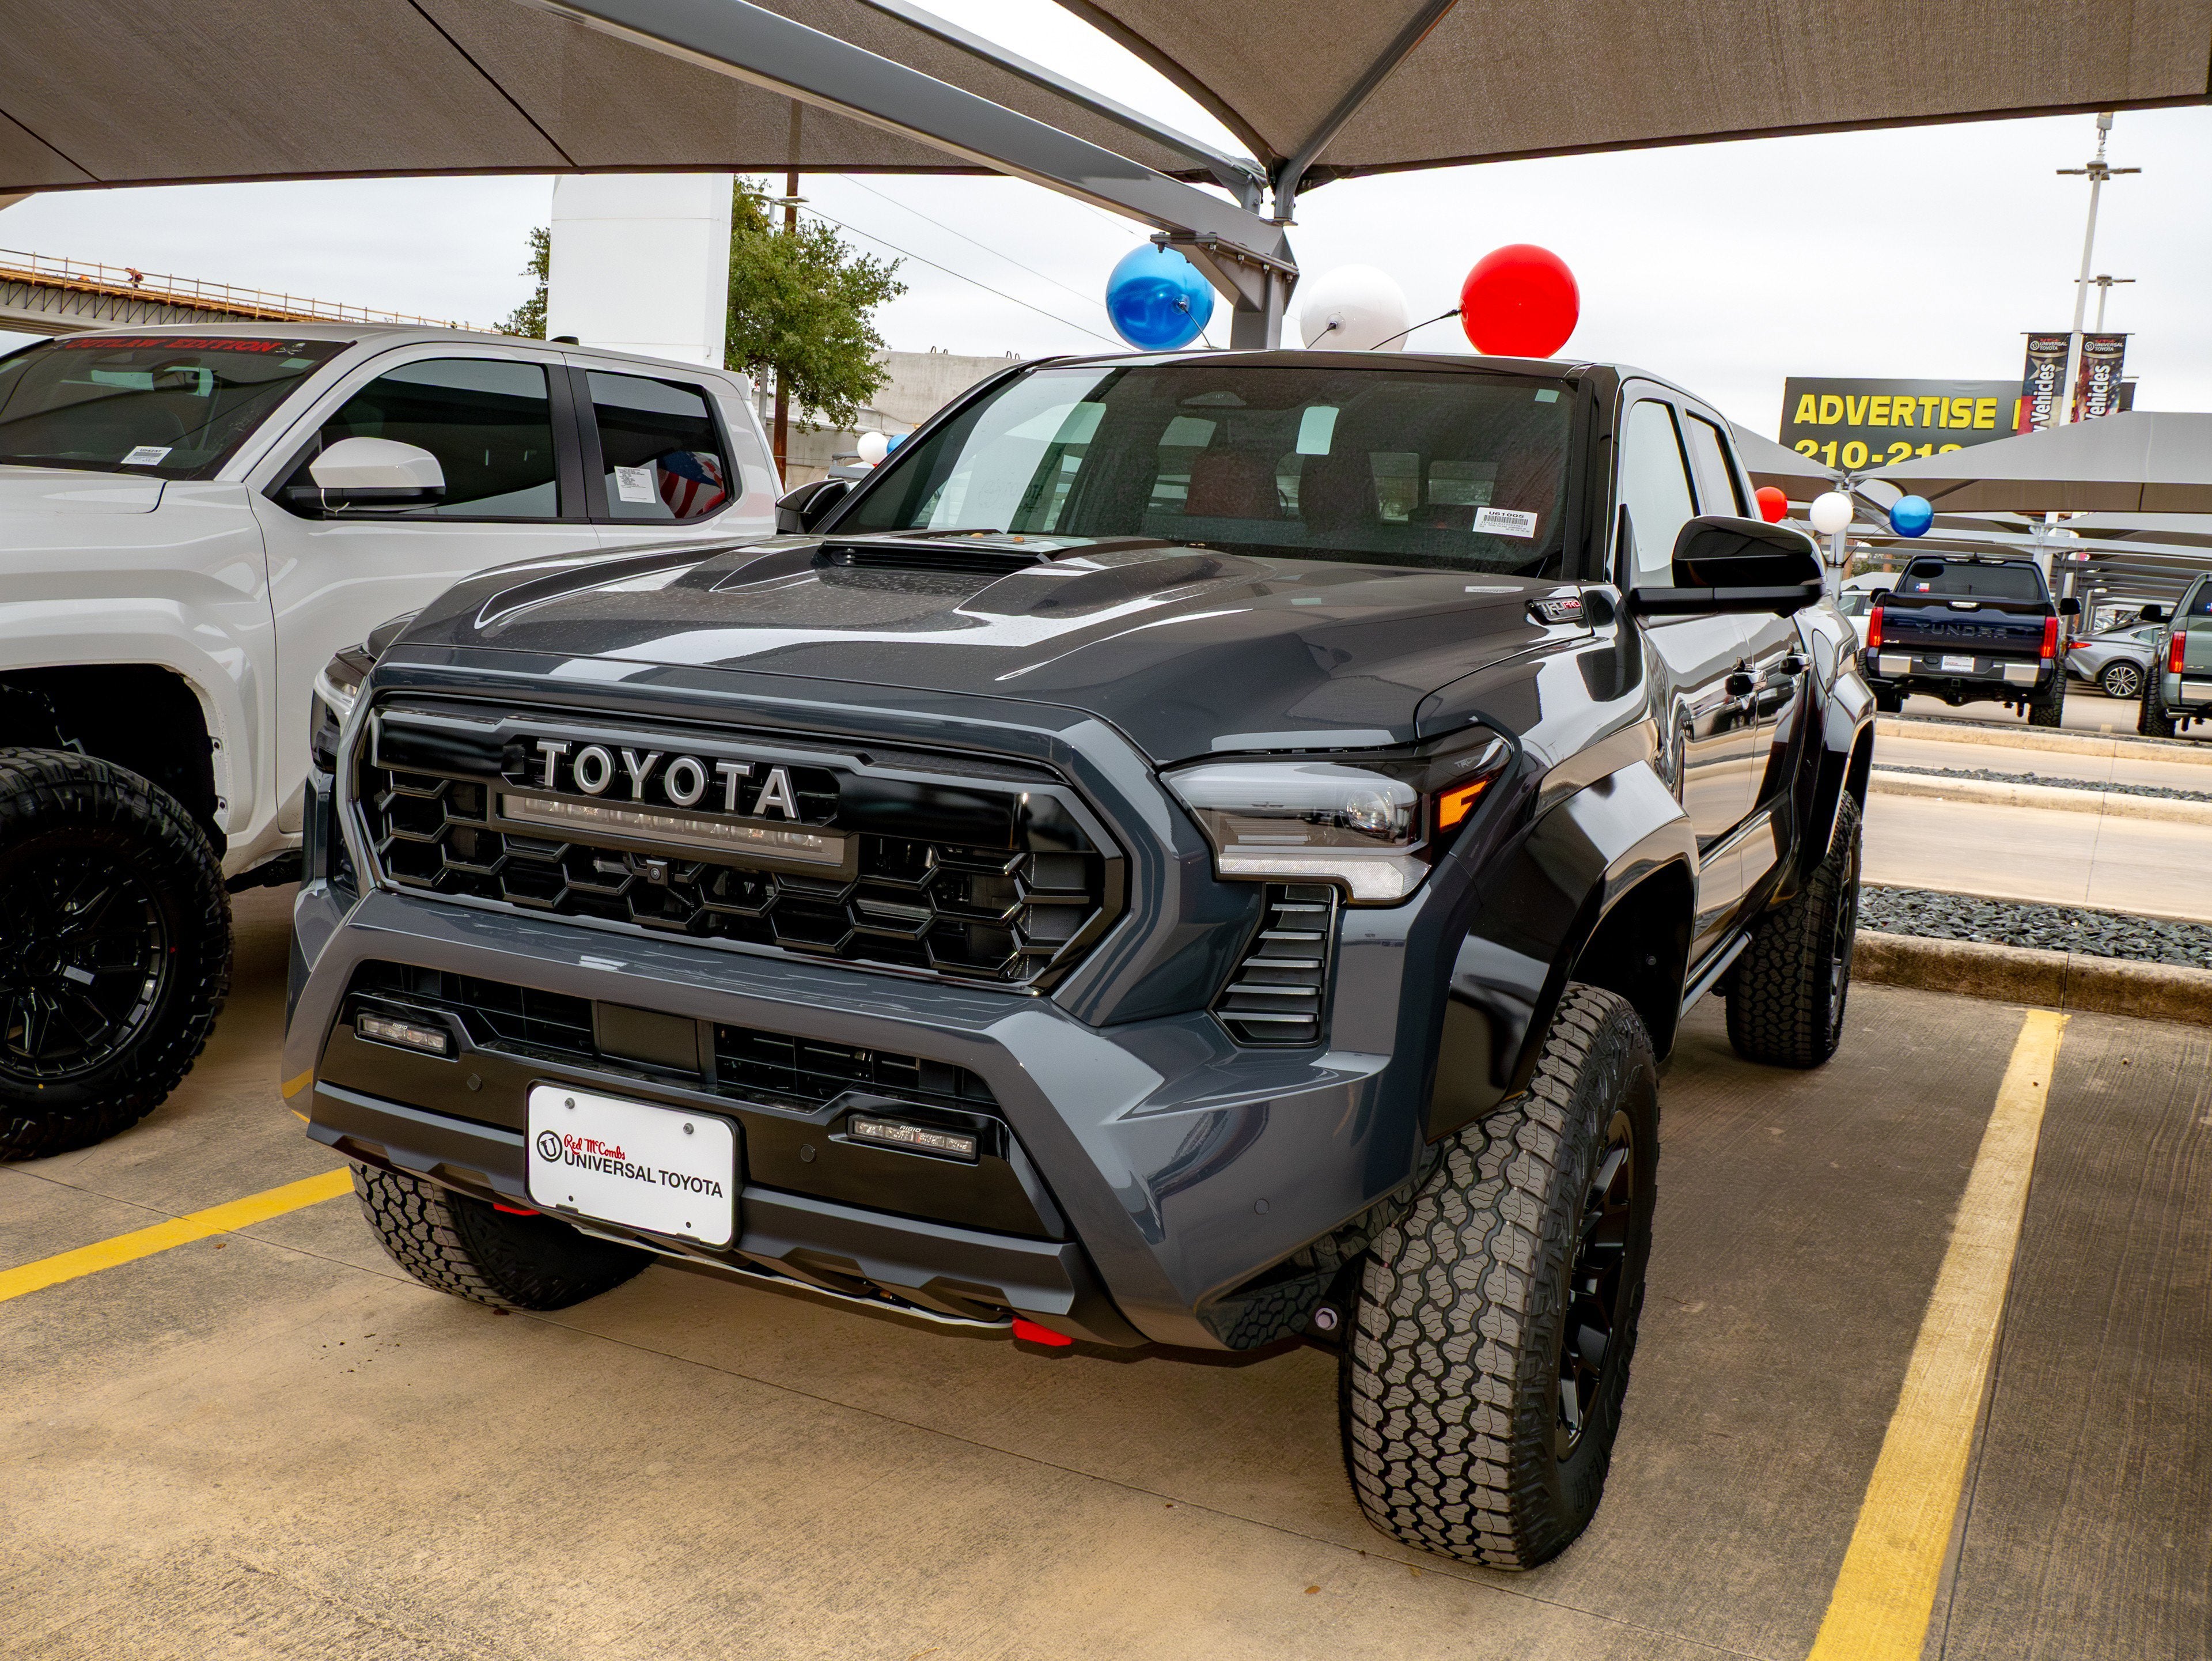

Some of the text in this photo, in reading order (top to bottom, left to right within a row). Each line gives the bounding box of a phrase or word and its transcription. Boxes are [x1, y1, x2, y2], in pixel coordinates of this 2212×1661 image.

[165, 339, 284, 352] EDITION
[2030, 364, 2055, 423] Vehicles
[1793, 394, 1998, 429] ADVERTISE
[1536, 600, 1581, 616] TRD PRO
[536, 739, 801, 822] TOYOTA
[563, 1134, 582, 1155] Red
[584, 1138, 626, 1160] McCombs
[564, 1150, 724, 1198] UNIVERSAL TOYOTA
